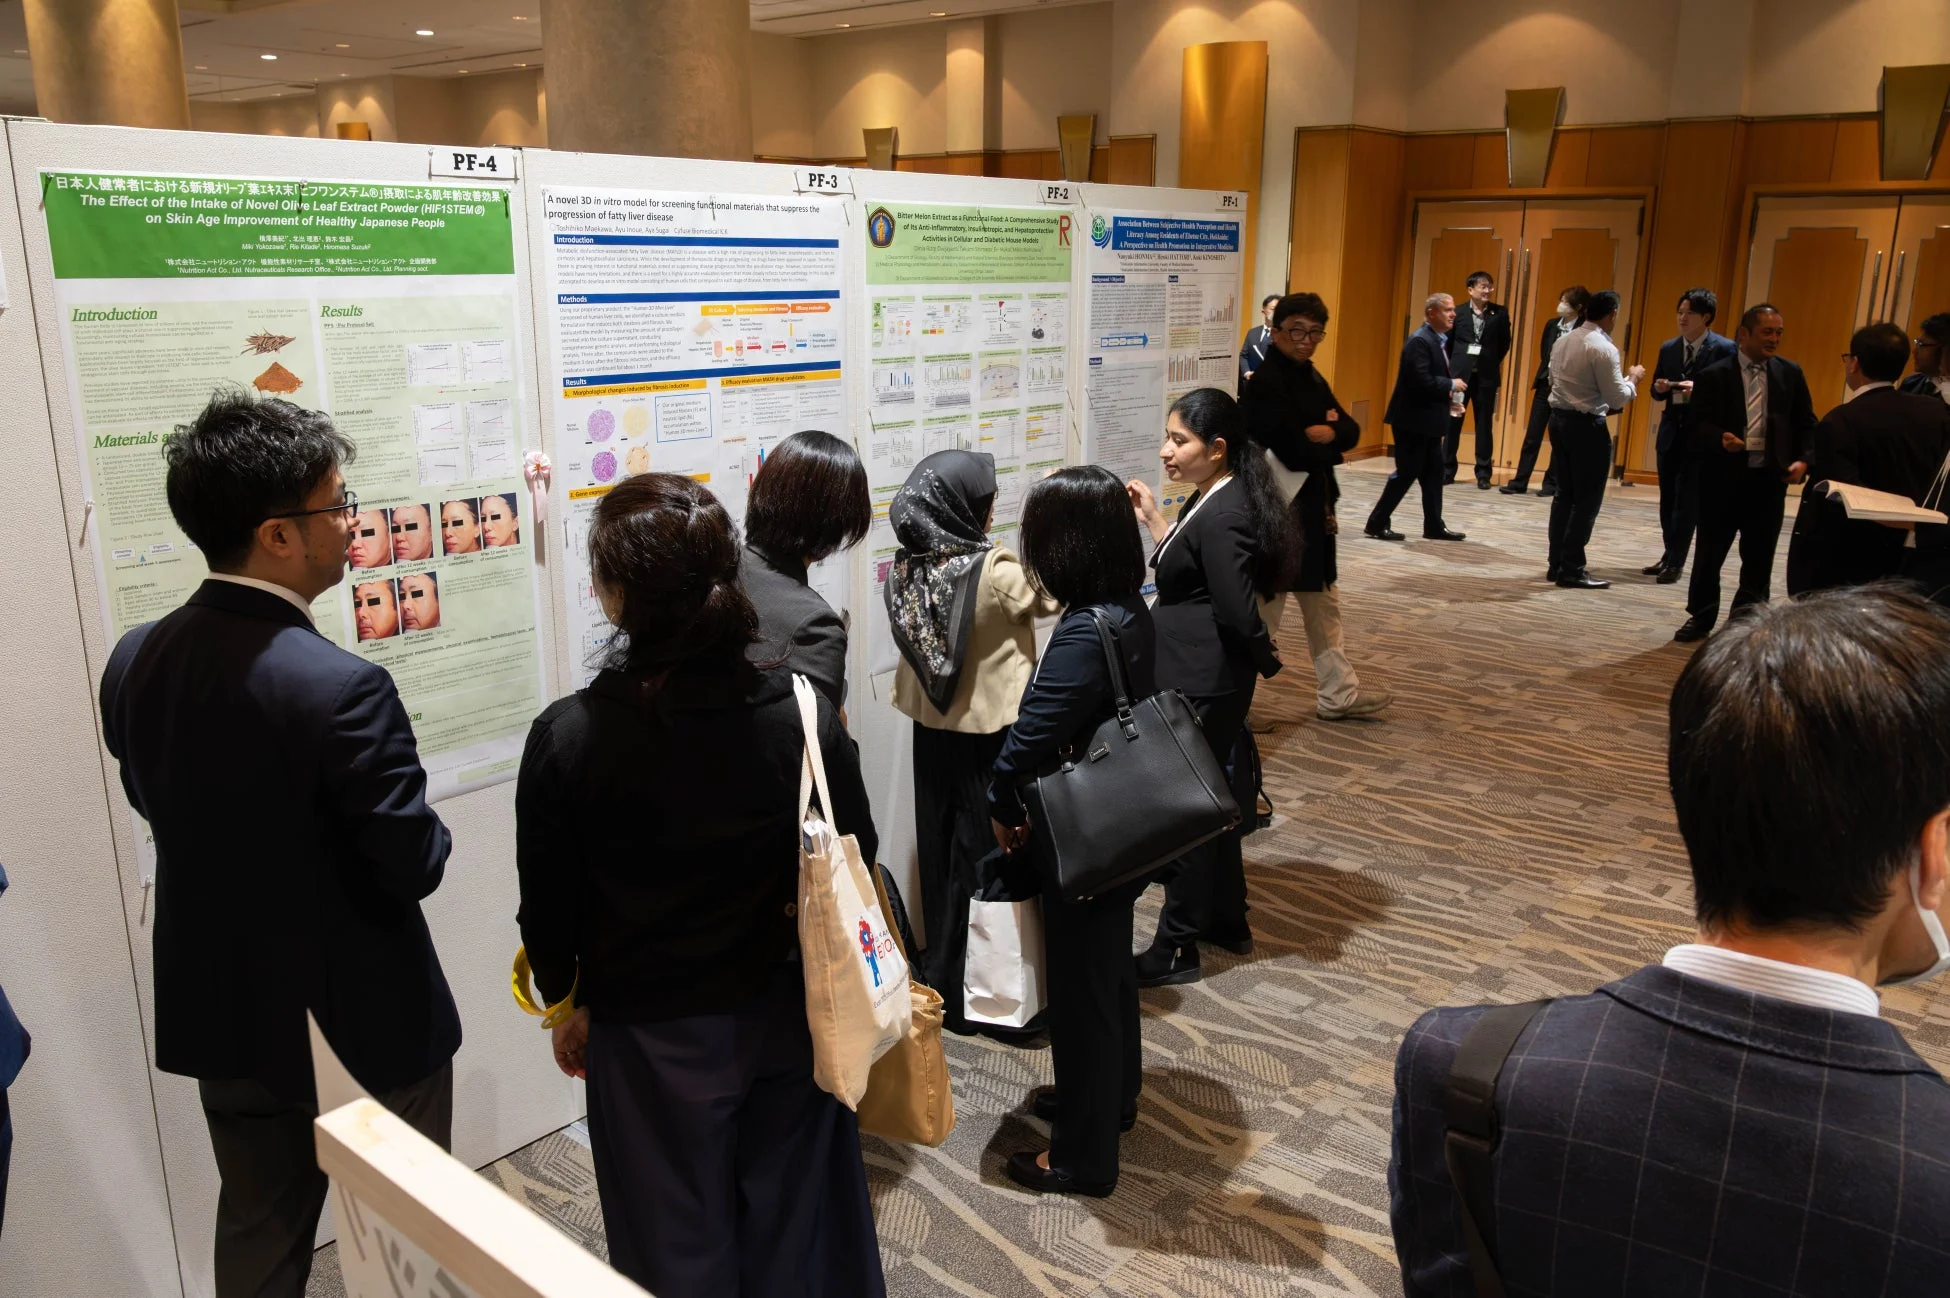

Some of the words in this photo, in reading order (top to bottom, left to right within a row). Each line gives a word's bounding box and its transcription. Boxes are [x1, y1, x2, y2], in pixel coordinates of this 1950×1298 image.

[452, 153, 497, 172] PF-4
[808, 172, 838, 188] PF-3
[1048, 186, 1068, 199] PF-2
[80, 194, 105, 206] The
[109, 195, 148, 207] Effect
[151, 196, 164, 208] of
[167, 196, 186, 208] the
[191, 197, 227, 209] Intake
[230, 198, 243, 209] of
[246, 198, 278, 210] Novel
[281, 200, 310, 211] Olive
[313, 200, 337, 212] Leaf
[340, 202, 378, 213] Extract
[380, 202, 418, 214] Powder
[548, 195, 553, 203] A
[556, 196, 578, 204] novel
[581, 196, 592, 204] 3D
[604, 198, 622, 206] vitro
[624, 198, 647, 207] model
[649, 199, 659, 207] for
[662, 200, 695, 210] screening
[697, 201, 732, 210] functional
[734, 202, 764, 211] materials
[766, 203, 779, 212] that
[780, 205, 808, 213] suppress
[810, 204, 820, 213] the
[1222, 196, 1238, 207] PF-1
[145, 214, 162, 224] on
[166, 213, 193, 224] Skin
[196, 213, 220, 227] Age
[224, 214, 299, 228] Improvement
[302, 215, 314, 226] of
[316, 216, 357, 229] Healthy
[360, 217, 408, 229] Japanese
[411, 218, 445, 229] People
[548, 211, 596, 220] progression
[598, 211, 606, 220] of
[608, 211, 626, 221] fatty
[628, 212, 644, 220] liver
[646, 212, 674, 221] disease
[919, 224, 967, 233] Anti-Inflammatory,
[1059, 215, 1071, 246] R
[72, 306, 158, 322] Introduction
[320, 305, 363, 317] Results
[93, 431, 158, 448] Materials
